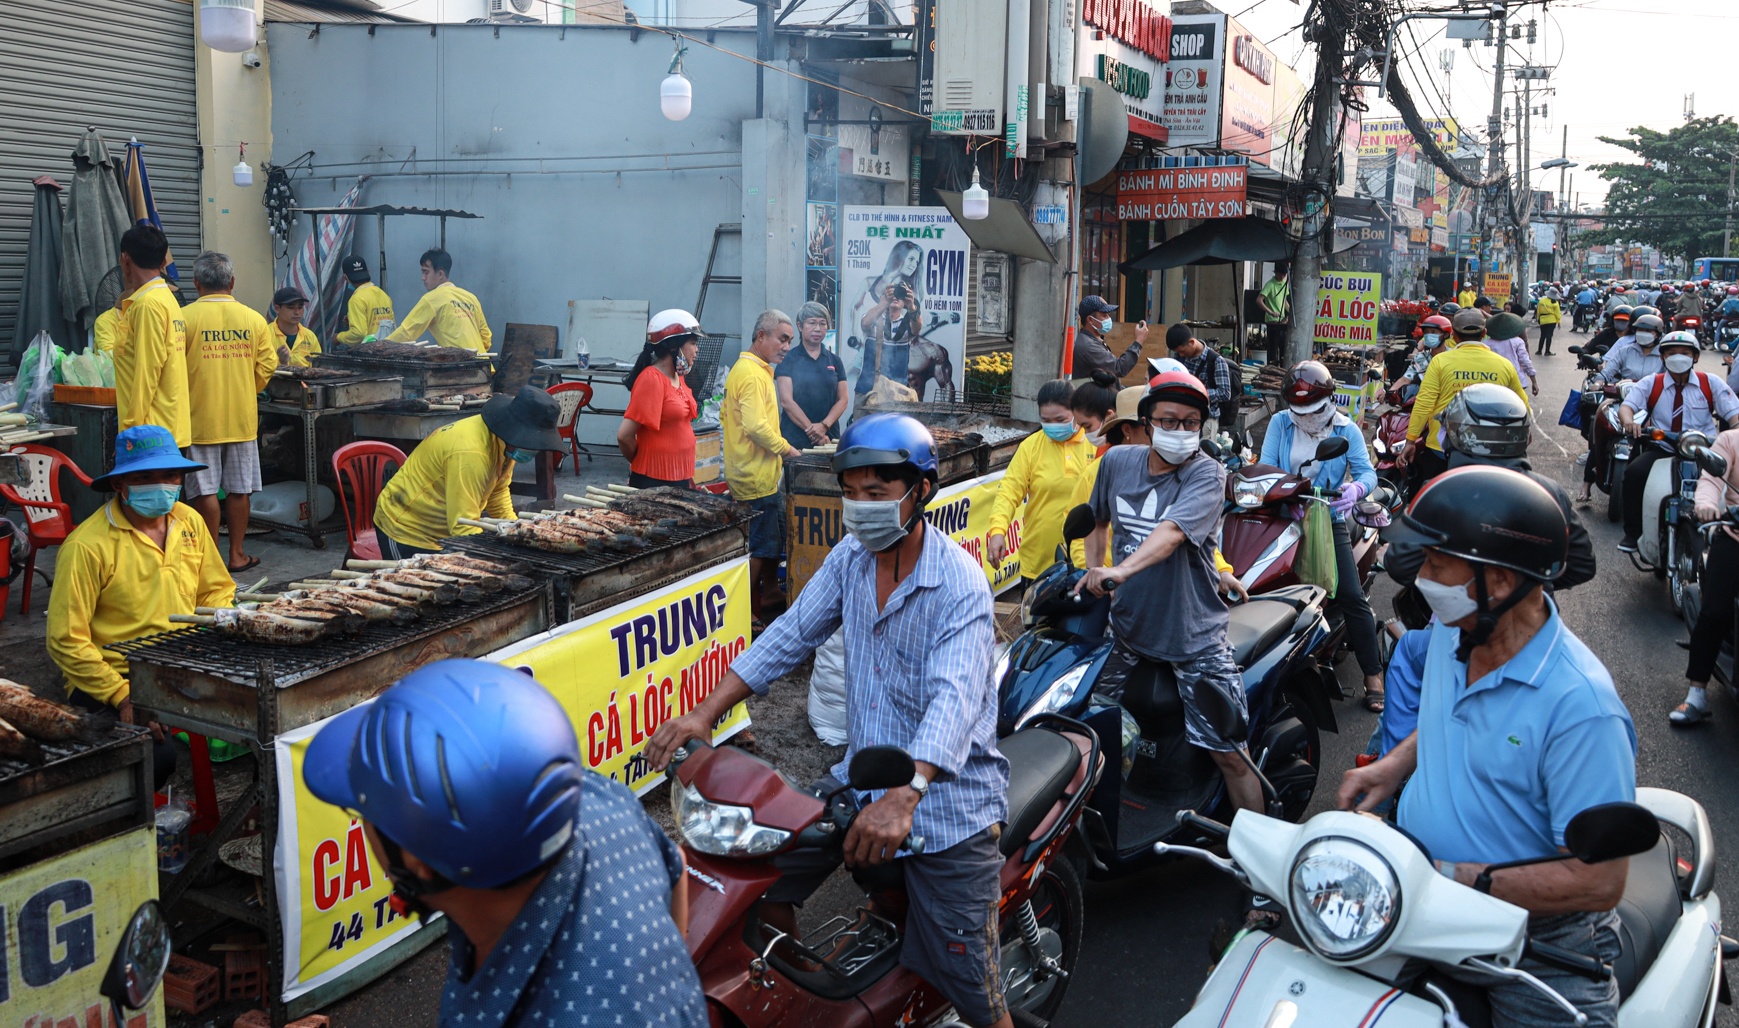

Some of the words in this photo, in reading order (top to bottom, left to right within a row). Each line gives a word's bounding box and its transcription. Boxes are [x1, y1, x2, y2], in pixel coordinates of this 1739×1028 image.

[1172, 34, 1205, 57] SHOP
[1099, 54, 1128, 93] VEGAN
[1128, 67, 1150, 99] FOOD
[1120, 172, 1155, 191] BÁNH
[1159, 170, 1174, 190] MÌ
[1178, 170, 1208, 189] BÌNH
[1211, 172, 1244, 191] ĐỊNH
[849, 213, 860, 221] CLB
[862, 214, 870, 222] TD
[884, 212, 900, 222] HÌNH
[901, 214, 906, 222] &
[908, 214, 935, 223] FITNESS
[937, 215, 953, 223] NAM
[1119, 200, 1151, 219] BÁNH
[1155, 195, 1188, 218] CUỐN
[1192, 198, 1215, 217] TÂY
[1219, 199, 1243, 217] SƠN
[866, 225, 890, 240] ĐỆ
[895, 224, 945, 239] NHẤT
[1360, 227, 1386, 240] BON
[848, 240, 871, 256] 250K
[852, 260, 871, 270] Tháng
[926, 249, 965, 297] GYM
[1348, 278, 1372, 295] BỤI
[949, 301, 962, 312] 10M
[1339, 297, 1376, 321] LÓC
[1350, 324, 1373, 341] MÍA
[1454, 371, 1498, 381] TRUNG
[610, 584, 728, 679] TRUNG
[588, 690, 624, 768] CÁ
[629, 673, 674, 748] LÓC
[313, 818, 373, 912] CÁ
[328, 912, 364, 951] 44
